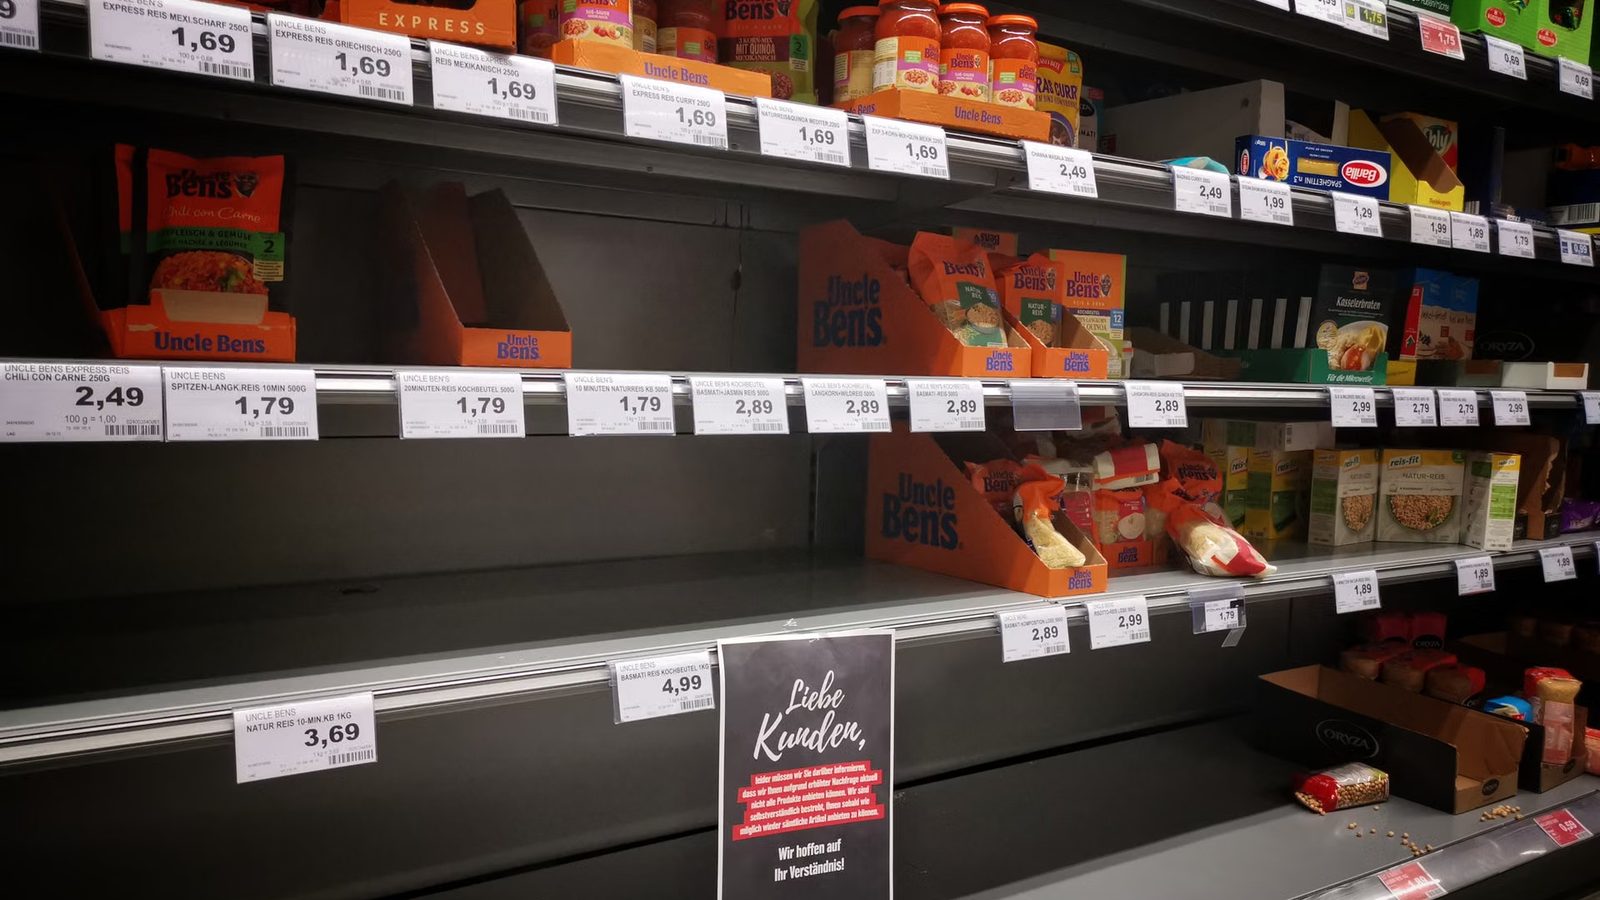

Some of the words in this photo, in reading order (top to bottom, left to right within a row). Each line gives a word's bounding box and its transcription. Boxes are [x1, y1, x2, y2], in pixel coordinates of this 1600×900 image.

[103, 2, 144, 16] EXPRESS
[147, 9, 168, 20] REIS
[169, 13, 227, 29] MEXI.SCHARF
[228, 23, 249, 33] 250G
[379, 12, 486, 36] EXPRESS
[1363, 10, 1382, 24] 1,75
[274, 19, 303, 31] UNCLE
[304, 25, 327, 35] BENS
[171, 27, 236, 53] 1,69
[275, 30, 313, 43] EXPRESS
[315, 36, 334, 47] REIS
[335, 39, 382, 54] GRIECHISCH
[383, 47, 402, 57] 250G
[1437, 31, 1456, 46] 1,75
[335, 52, 391, 77] 1,69
[434, 48, 459, 59] UNCLE
[460, 51, 480, 61] BENS
[480, 54, 514, 67] EXPRESS
[951, 58, 974, 69] Bens
[1504, 52, 1520, 66] 0,69
[435, 56, 452, 66] REIS
[454, 60, 501, 74] MEXIKANISCH
[502, 68, 519, 77] 250G
[644, 61, 679, 80] Uncle
[680, 68, 708, 85] Bens
[1575, 74, 1589, 87] 0,69
[487, 77, 536, 100] 1,69
[675, 106, 716, 127] 1,69
[954, 106, 979, 122] Uncle
[980, 110, 1001, 125] Bens
[799, 126, 834, 145] 1,69
[905, 143, 938, 160] 1,69
[1059, 163, 1087, 179] 2,49
[1346, 166, 1377, 182] Barilla
[1304, 176, 1343, 188] SPAGHETTINI
[1199, 185, 1222, 199] 2,49
[1263, 195, 1284, 209] 1,99
[1353, 206, 1373, 219] 1,29
[1430, 222, 1447, 235] 1,99
[1468, 227, 1484, 240] 1,89
[263, 239, 274, 254] 2
[1514, 235, 1529, 247] 1,79
[944, 260, 979, 278] Bens
[1021, 265, 1045, 279] Uncle
[1013, 272, 1046, 292] Bens
[1073, 271, 1099, 285] Uncle
[828, 272, 880, 307] Uncle
[1066, 279, 1100, 299] Bens
[1027, 302, 1047, 311] NATUR-
[1336, 296, 1381, 310] Kasselerbraten
[813, 300, 883, 348] Bens
[1113, 312, 1122, 323] 12
[154, 331, 213, 352] Uncle
[217, 334, 266, 353] Bens
[506, 334, 538, 347] Uncle
[496, 342, 540, 360] Bens
[991, 350, 1012, 361] Uncle
[1070, 351, 1089, 362] Uncle
[4, 365, 38, 373] UNCLE
[38, 365, 64, 374] BENS
[65, 366, 107, 374] EXPRESS
[109, 366, 130, 374] REIS
[986, 358, 1014, 372] Bens
[1063, 358, 1090, 372] Bens
[4, 373, 30, 381] CHILI
[32, 373, 52, 382] CON
[54, 374, 87, 382] CARNE
[88, 374, 111, 382] 250G
[170, 372, 201, 380] UNCLE
[202, 372, 226, 380] BENS
[428, 375, 450, 383] BEN'S
[1327, 373, 1337, 382] Für
[1336, 373, 1345, 382] die
[171, 383, 260, 392] SPITZEN-LANGK.REIS
[263, 384, 286, 392] 10MIN
[287, 385, 307, 393] 500G
[404, 385, 457, 393] 20MINUTEN-REIS
[75, 386, 144, 411] 2,49
[620, 396, 661, 415] 1,79
[235, 396, 295, 419] 1,79
[456, 397, 505, 418] 1,79
[735, 399, 773, 417] 2,89
[845, 399, 880, 416] 2,89
[946, 399, 977, 416] 2,89
[1155, 400, 1179, 413] 2,89
[1352, 401, 1371, 415] 2,99
[1413, 403, 1430, 415] 2,79
[1458, 403, 1474, 415] 2,79
[1509, 402, 1523, 414] 2,99
[1390, 455, 1420, 466] reis-fit
[1402, 472, 1445, 480] NATUR-REIS
[898, 472, 956, 510] Uncle
[881, 492, 958, 550] Bens
[1556, 557, 1571, 567] 1,89
[1073, 569, 1092, 578] Uncle
[1473, 568, 1489, 580] 1,89
[1067, 576, 1093, 590] Bens
[1354, 583, 1372, 596] 1,89
[1118, 613, 1142, 628] 2,99
[1219, 611, 1235, 622] 1,79
[1031, 625, 1059, 642] 2,89
[662, 674, 702, 696] 4,99
[785, 670, 846, 715] Liebe
[245, 710, 273, 722] UNCLE
[274, 708, 297, 719] BENS
[246, 722, 275, 733] NATUR
[276, 719, 295, 729] REIS
[297, 715, 335, 726] 10-MIN.KB
[337, 712, 352, 721] 1KG
[304, 722, 360, 749] 3,69
[753, 710, 866, 762] Kunden,
[1324, 728, 1370, 750] ORYZA
[755, 776, 771, 785] leider
[771, 772, 793, 783] müssen
[793, 770, 803, 779] wir
[803, 769, 812, 778] Sie
[812, 766, 833, 777] darüber
[833, 764, 866, 775] informieren,
[742, 789, 757, 799] dass
[757, 788, 767, 797] wir
[783, 781, 808, 794] aufgrund
[808, 779, 831, 789] erhöhter
[831, 776, 859, 787] Nachfrage
[859, 772, 878, 783] aktuell
[750, 801, 766, 810] nicht
[766, 798, 776, 808] alle
[776, 795, 802, 806] Produkte
[802, 792, 825, 802] anbieten
[825, 790, 847, 799] können.
[847, 787, 857, 795] Wir
[857, 785, 870, 794] sind
[740, 824, 762, 836] möglich
[762, 822, 781, 832] wieder
[781, 817, 809, 829] sämtliche
[808, 814, 827, 825] Artikel
[827, 812, 851, 821] anbieten
[850, 811, 858, 819] zu
[858, 808, 879, 818] können.
[778, 846, 795, 861] Wir
[796, 842, 825, 858] hoffen
[826, 838, 842, 853] auf
[774, 867, 788, 882] Ihr
[789, 857, 845, 879] Verständnis!
